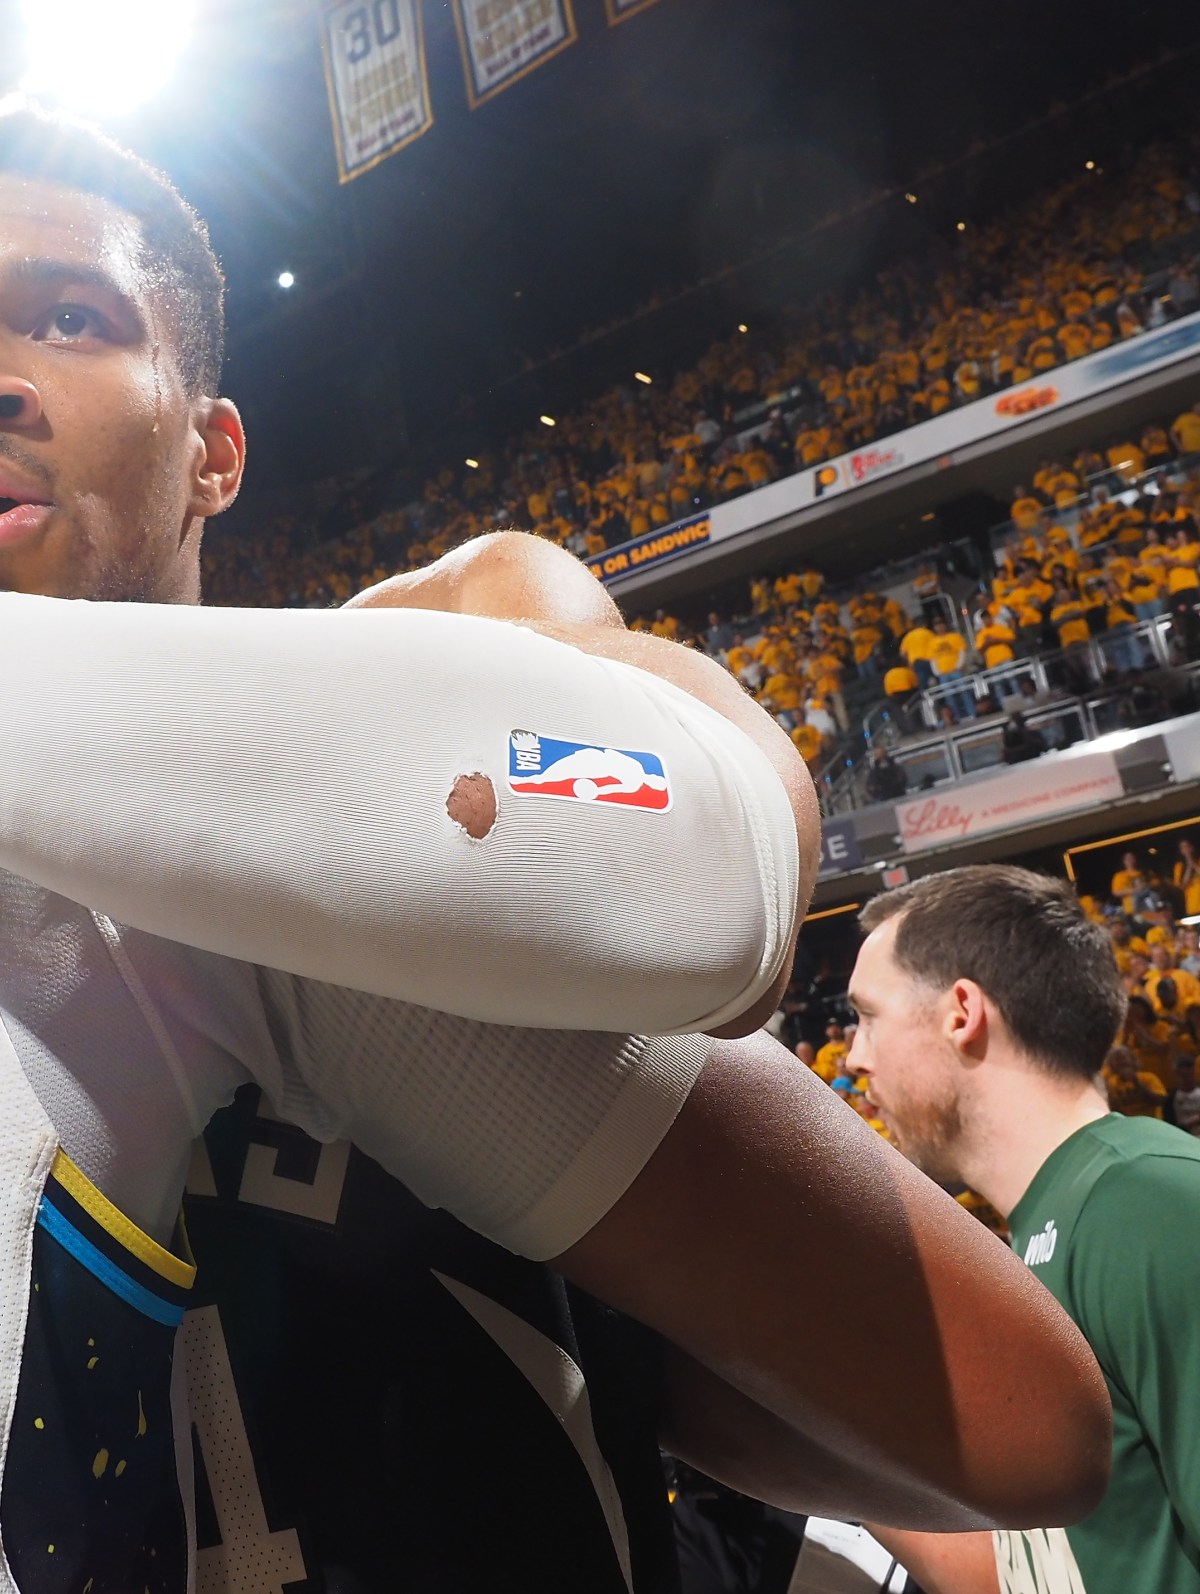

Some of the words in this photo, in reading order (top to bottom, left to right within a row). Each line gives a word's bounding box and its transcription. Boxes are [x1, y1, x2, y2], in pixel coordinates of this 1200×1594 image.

[343, 0, 401, 64] 30
[603, 553, 629, 575] OR
[903, 799, 973, 836] Lilly
